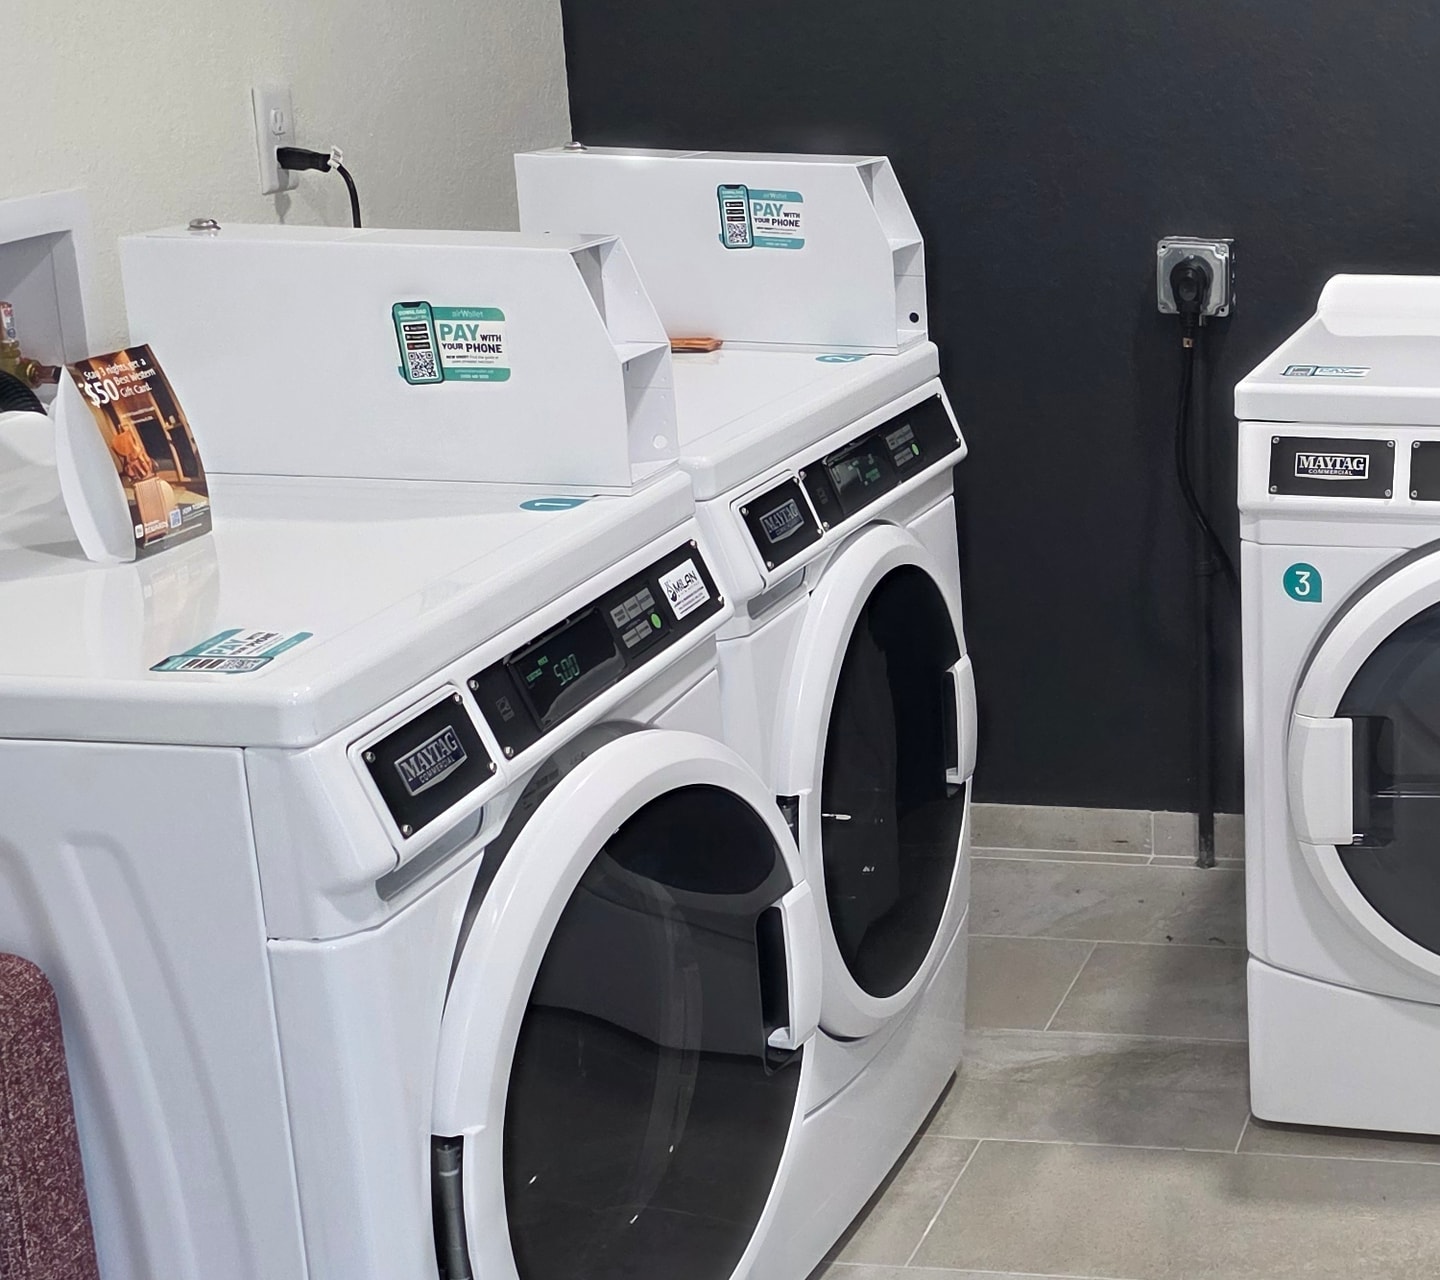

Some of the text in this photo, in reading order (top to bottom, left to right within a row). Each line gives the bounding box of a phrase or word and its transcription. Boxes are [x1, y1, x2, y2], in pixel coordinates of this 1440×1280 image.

[753, 202, 783, 217] PAY
[771, 218, 800, 227] PHONE
[452, 309, 484, 318] airWallet
[439, 323, 480, 342] PAY
[480, 334, 502, 342] WITH
[441, 342, 503, 354] YOUR PHONE
[84, 370, 101, 380] Stay
[99, 367, 106, 377] 3
[140, 358, 147, 366] a
[113, 368, 156, 386] Best Western
[84, 378, 120, 408] $50
[120, 386, 135, 398] Gift
[1299, 456, 1365, 471] MAYTAG
[1308, 468, 1353, 476] COMMERCIAL
[763, 503, 799, 533] MAYTAG
[673, 570, 698, 594] MILAN
[1294, 571, 1310, 596] 3
[207, 638, 246, 655] PAY
[400, 731, 458, 782] MAYTAG
[419, 756, 455, 783] COMMERCIAL
